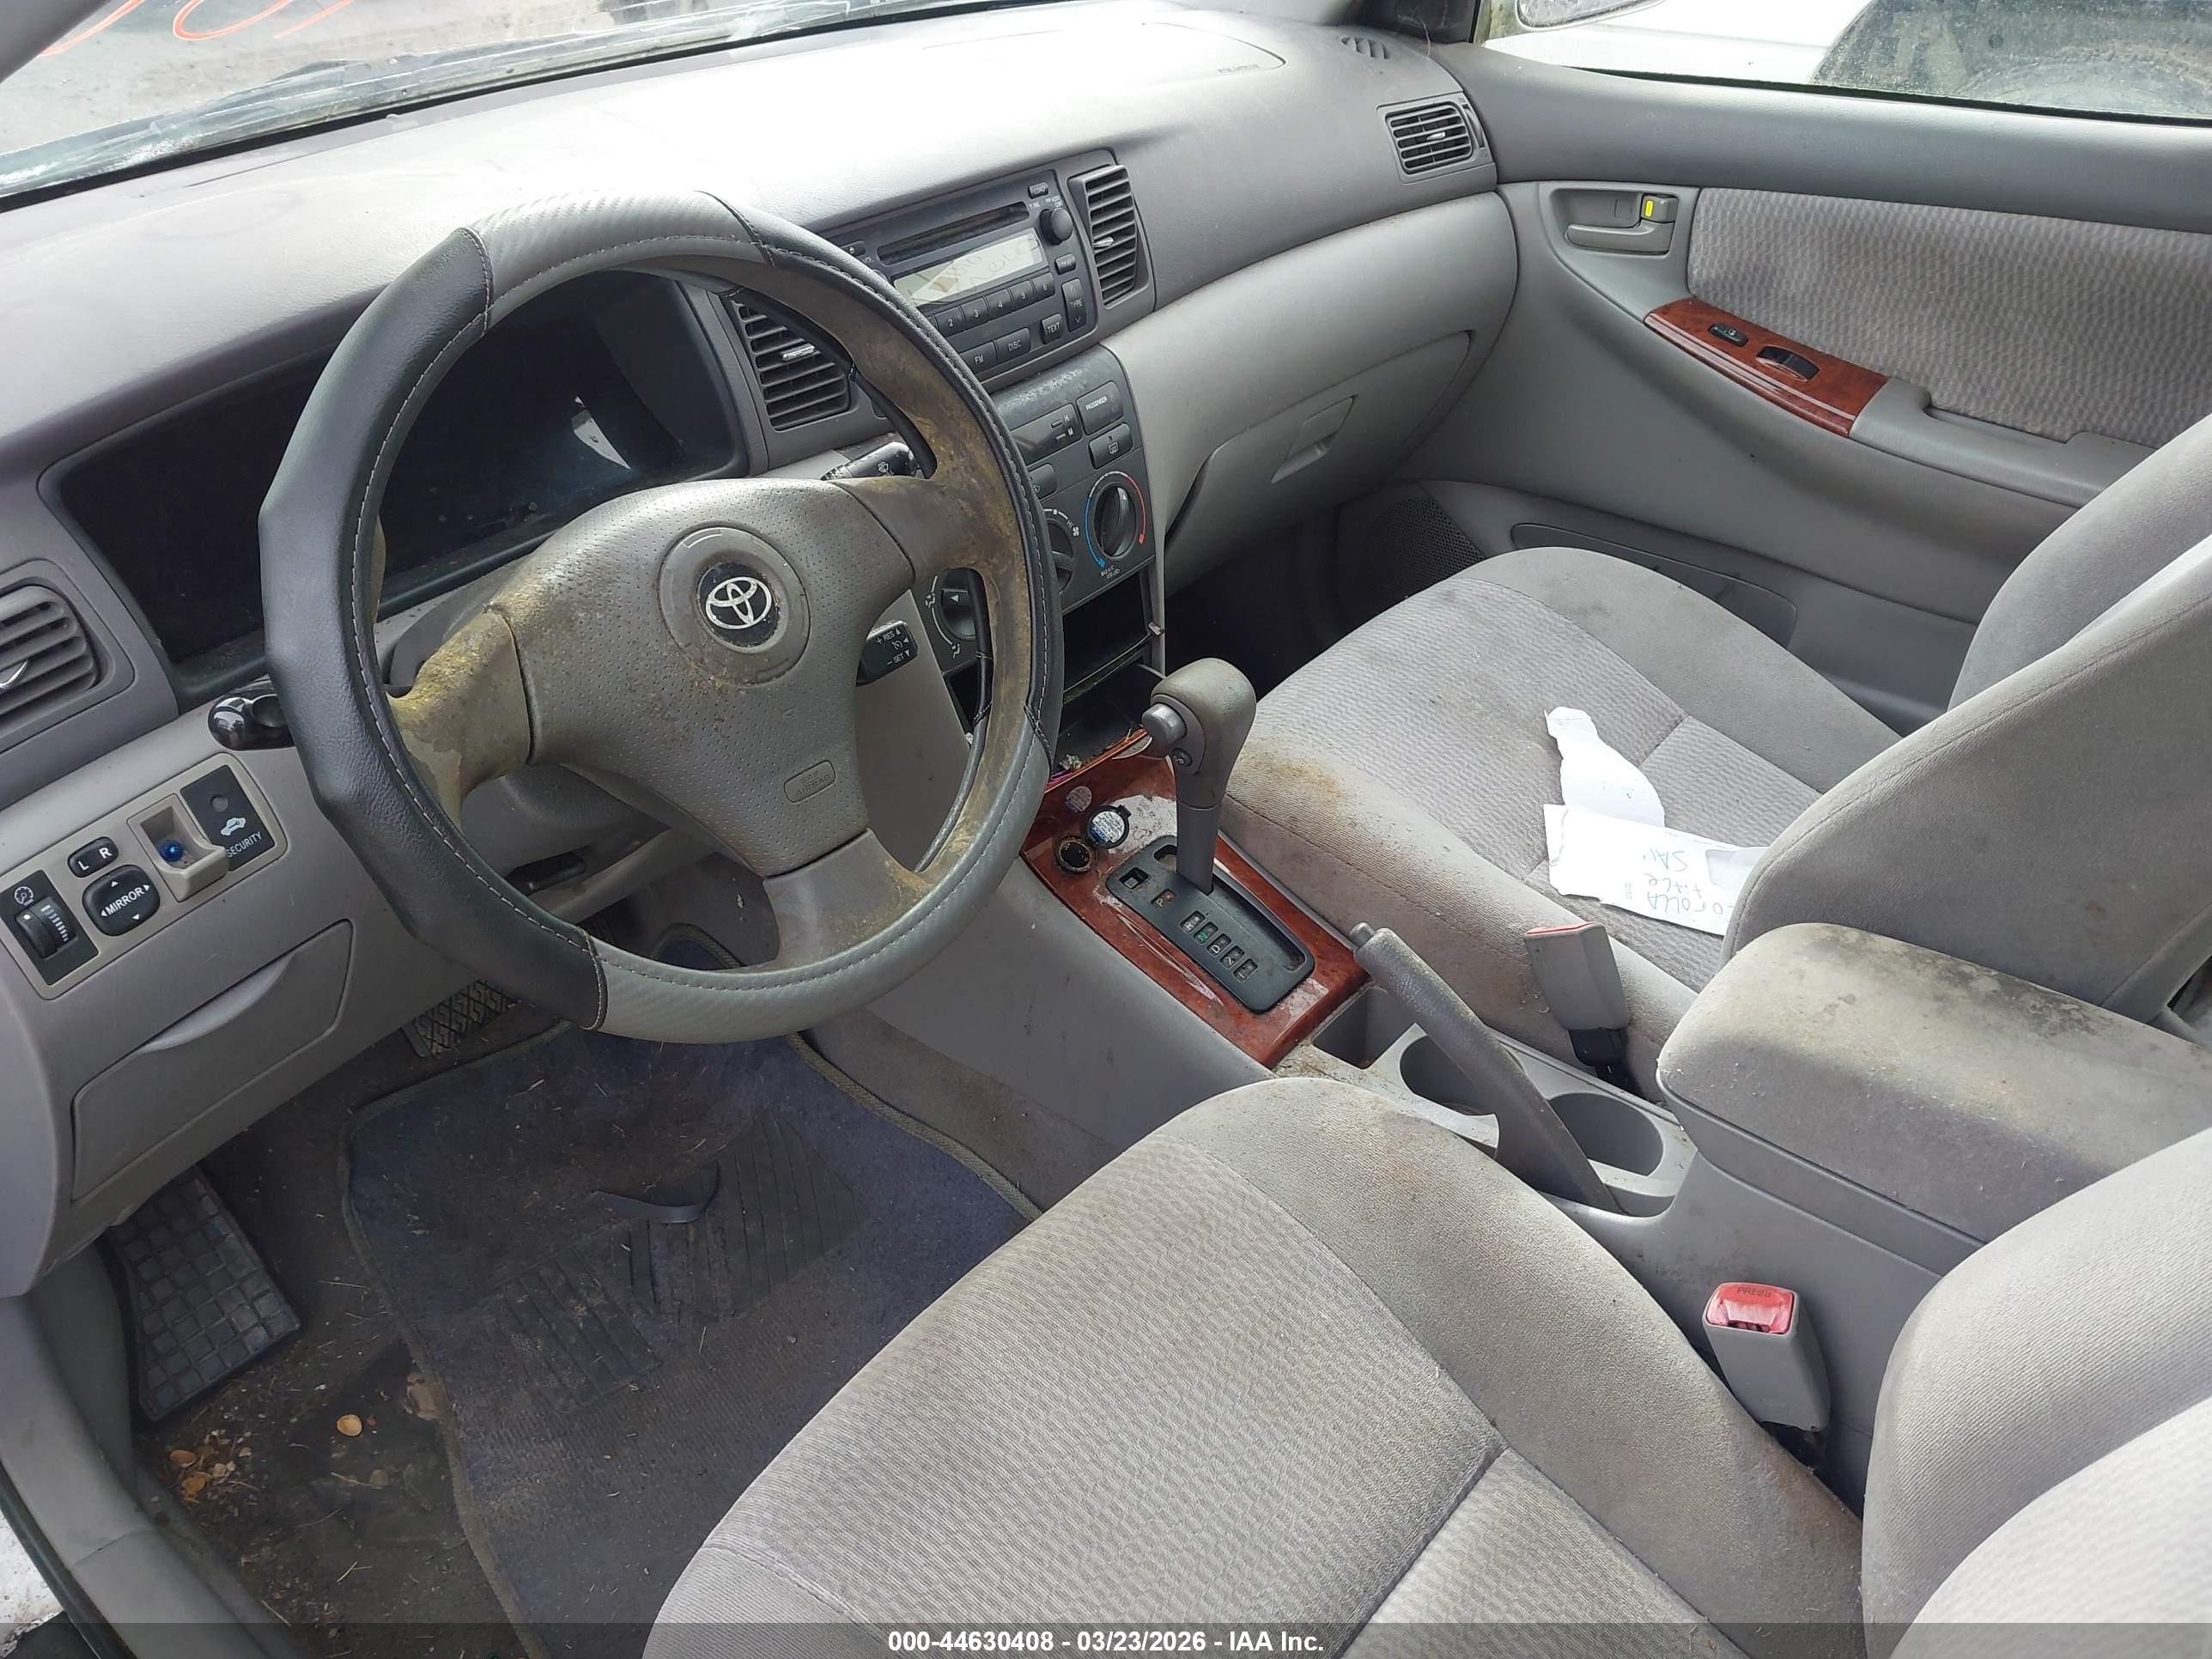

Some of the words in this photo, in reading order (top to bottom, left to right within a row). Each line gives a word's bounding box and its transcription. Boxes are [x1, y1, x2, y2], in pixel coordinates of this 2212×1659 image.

[998, 300, 1003, 308] 4
[974, 309, 979, 318] 3
[948, 318, 954, 327] 2
[1048, 321, 1060, 336] TEXT
[1008, 339, 1022, 351] DISC
[975, 355, 984, 364] FM
[1085, 396, 1108, 411] PASSENGER
[883, 630, 895, 641] RES
[893, 653, 904, 664] SET
[226, 831, 262, 858] SECURITY
[78, 860, 89, 871] L
[99, 847, 112, 859] R
[105, 887, 145, 915] MIRROR
[1155, 898, 1164, 908] P
[1184, 921, 1194, 933] R
[1197, 933, 1208, 944] N
[1210, 945, 1220, 954] D
[1224, 957, 1234, 967] 2
